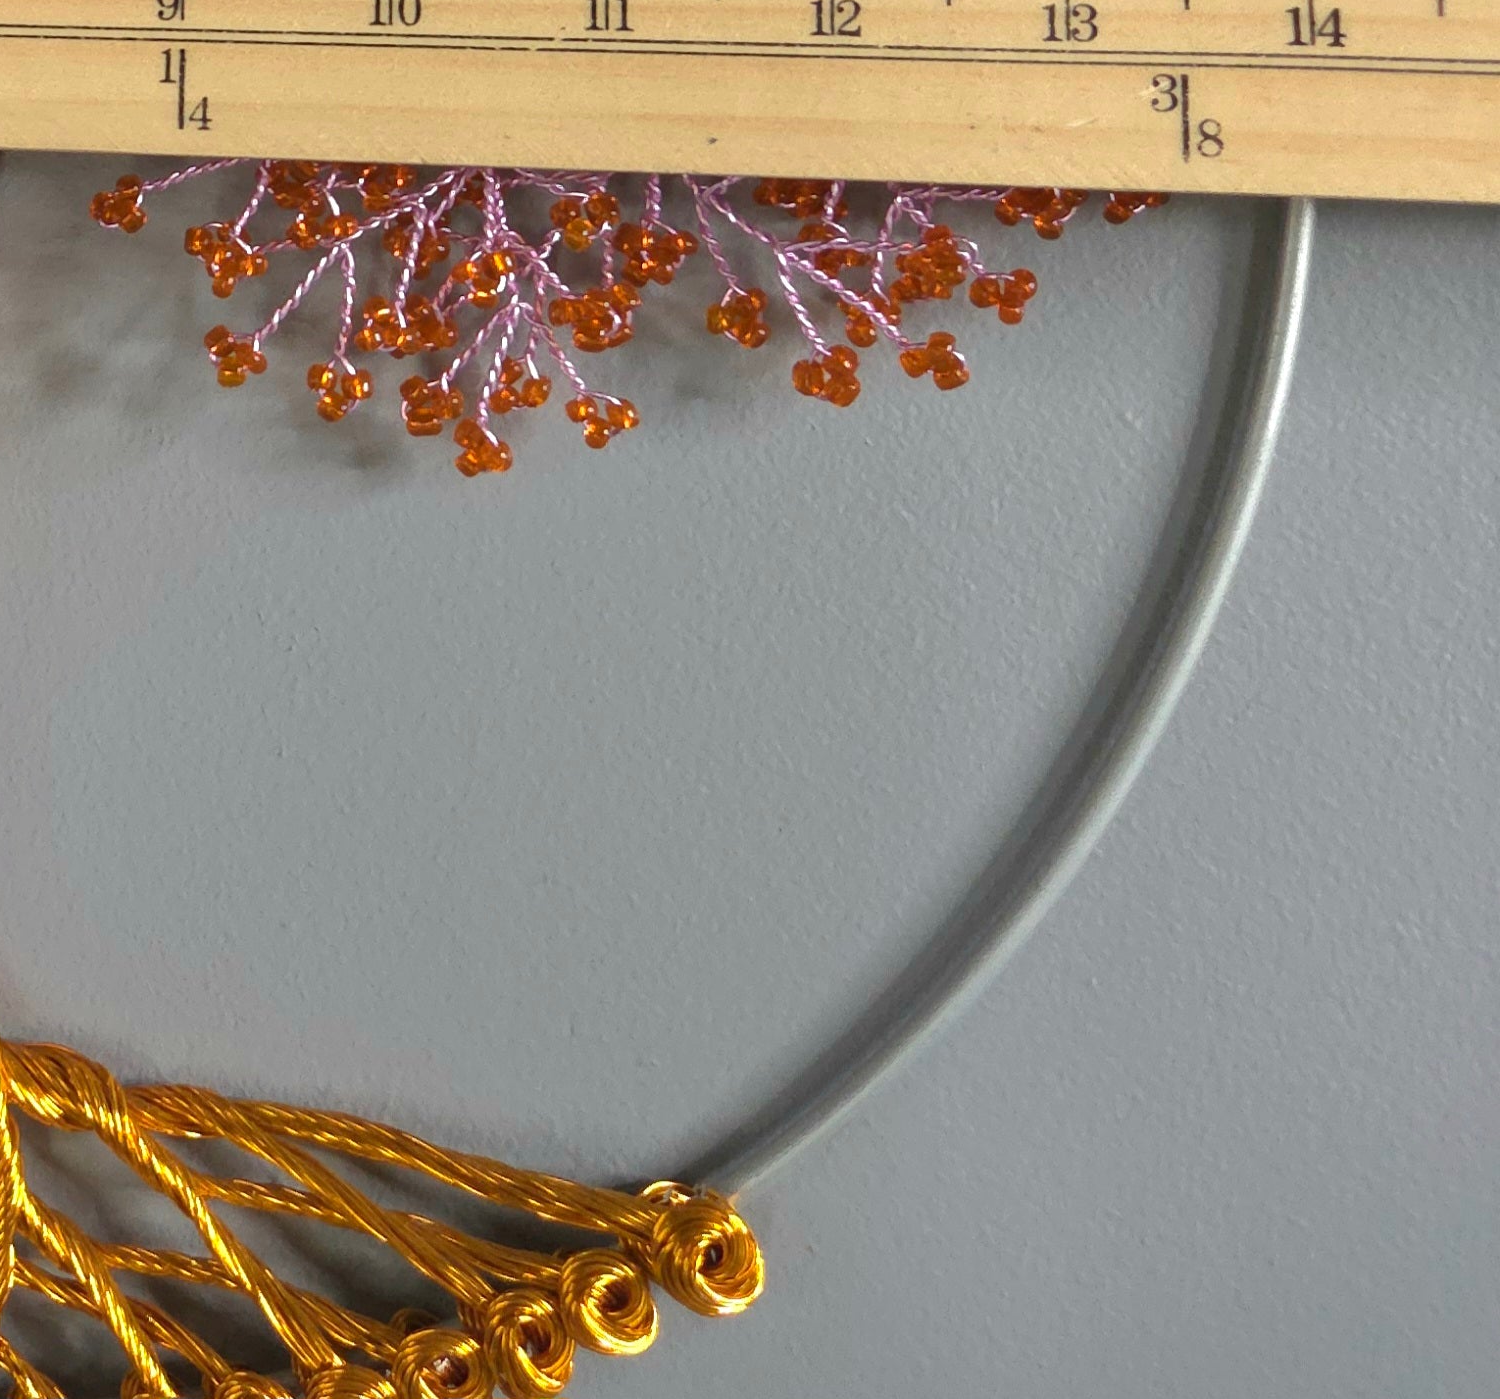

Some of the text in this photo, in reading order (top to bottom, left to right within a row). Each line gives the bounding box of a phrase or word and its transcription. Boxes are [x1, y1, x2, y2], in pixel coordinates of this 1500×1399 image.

[810, 0, 862, 37] 12
[1043, 3, 1099, 42] 13
[1286, 7, 1346, 47] 14
